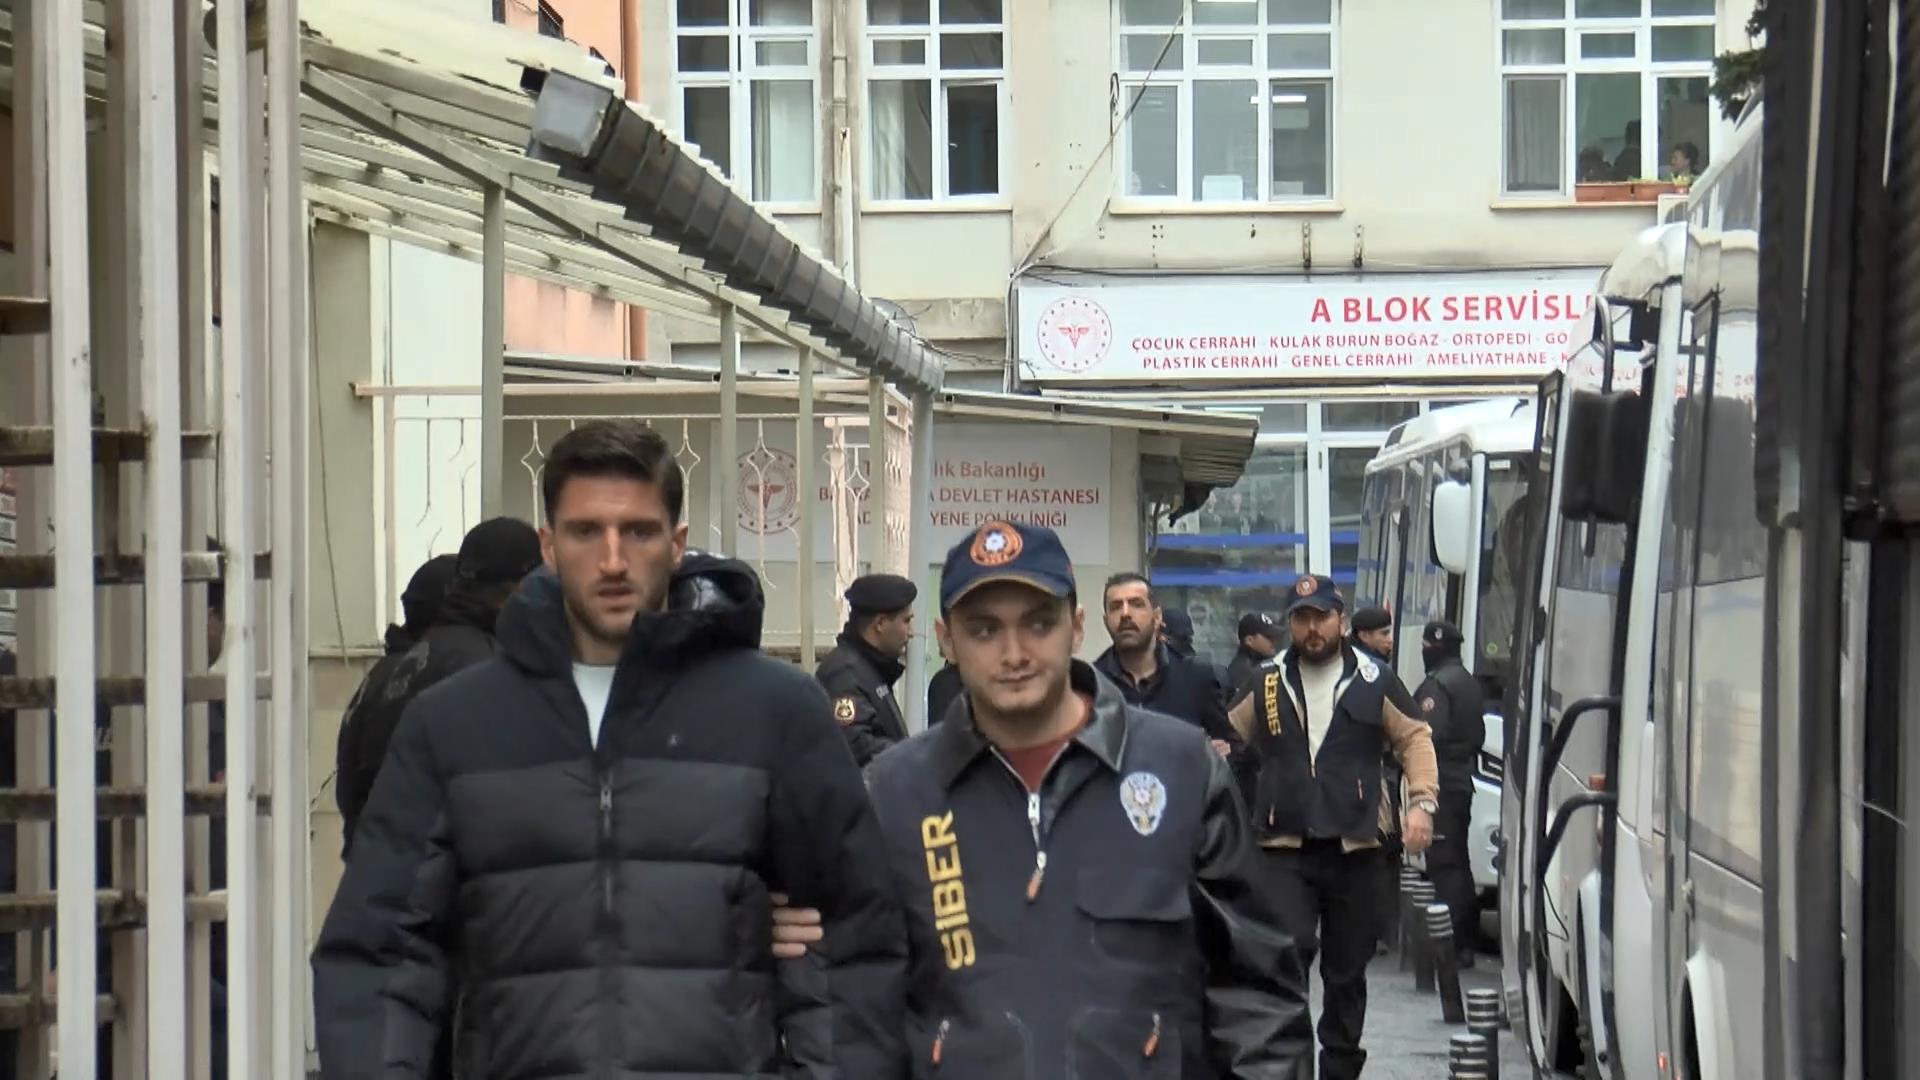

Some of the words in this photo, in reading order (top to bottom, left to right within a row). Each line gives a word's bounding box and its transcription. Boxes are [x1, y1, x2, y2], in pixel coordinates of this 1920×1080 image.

[1311, 298, 1331, 322] A
[1343, 297, 1431, 322] BLOK
[1442, 290, 1591, 321] SERVİSL
[1132, 337, 1184, 353] ÇOCUK
[1270, 335, 1321, 349] KULAK
[1326, 335, 1380, 348] BURUN
[1385, 331, 1439, 347] BOĞAZ
[1143, 356, 1206, 369] PLASTİK
[1291, 354, 1340, 367] GENEL
[933, 459, 955, 478] lık
[960, 460, 1046, 482] Bakanlığı
[940, 488, 1003, 502] DEVLET
[1007, 487, 1100, 504] HASTANESİ
[930, 512, 970, 526] YENE
